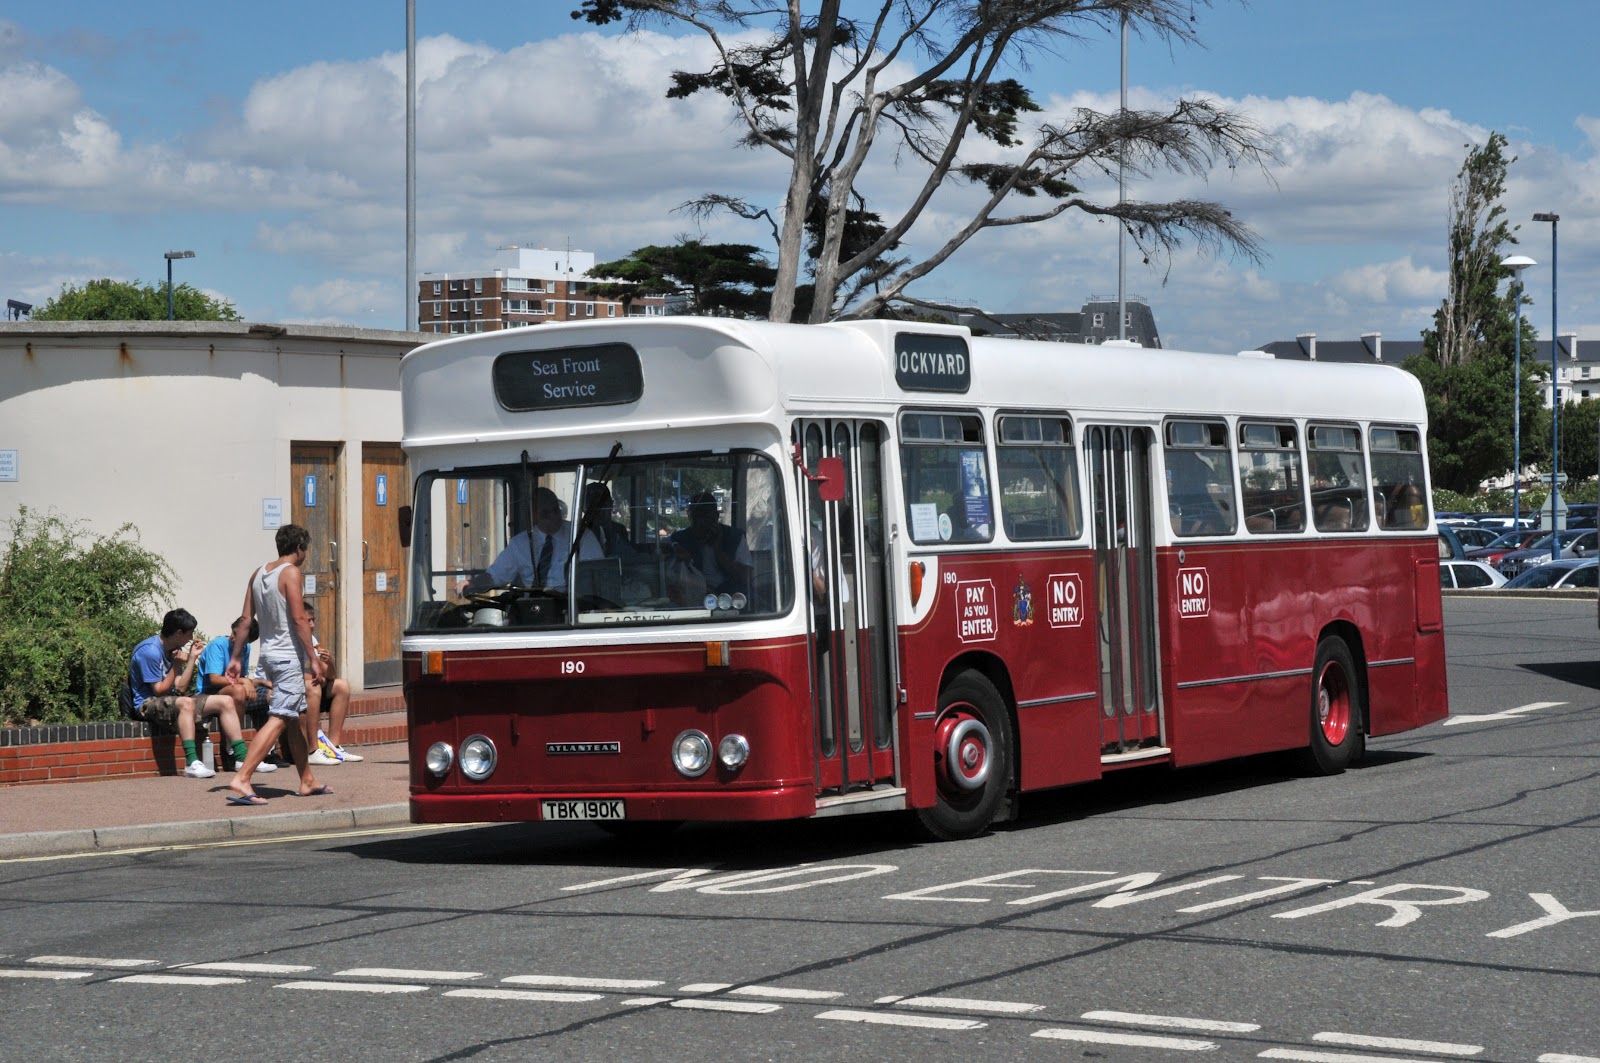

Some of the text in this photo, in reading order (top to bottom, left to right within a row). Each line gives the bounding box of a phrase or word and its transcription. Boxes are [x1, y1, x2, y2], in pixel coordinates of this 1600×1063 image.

[532, 358, 600, 376] Sea Front
[895, 351, 966, 375] OCKYARD
[543, 381, 596, 398] Service
[943, 572, 957, 584] 190
[1182, 573, 1203, 595] NO
[966, 587, 985, 603] PAY
[1053, 581, 1076, 604] NO
[964, 605, 989, 617] AS YOU
[1181, 598, 1206, 613] ENTRY
[1052, 607, 1079, 622] ENTRY
[962, 618, 993, 636] ENTER
[561, 661, 585, 674] 190
[548, 744, 618, 752] ATLANTEAN
[546, 802, 620, 819] TBK 190K
